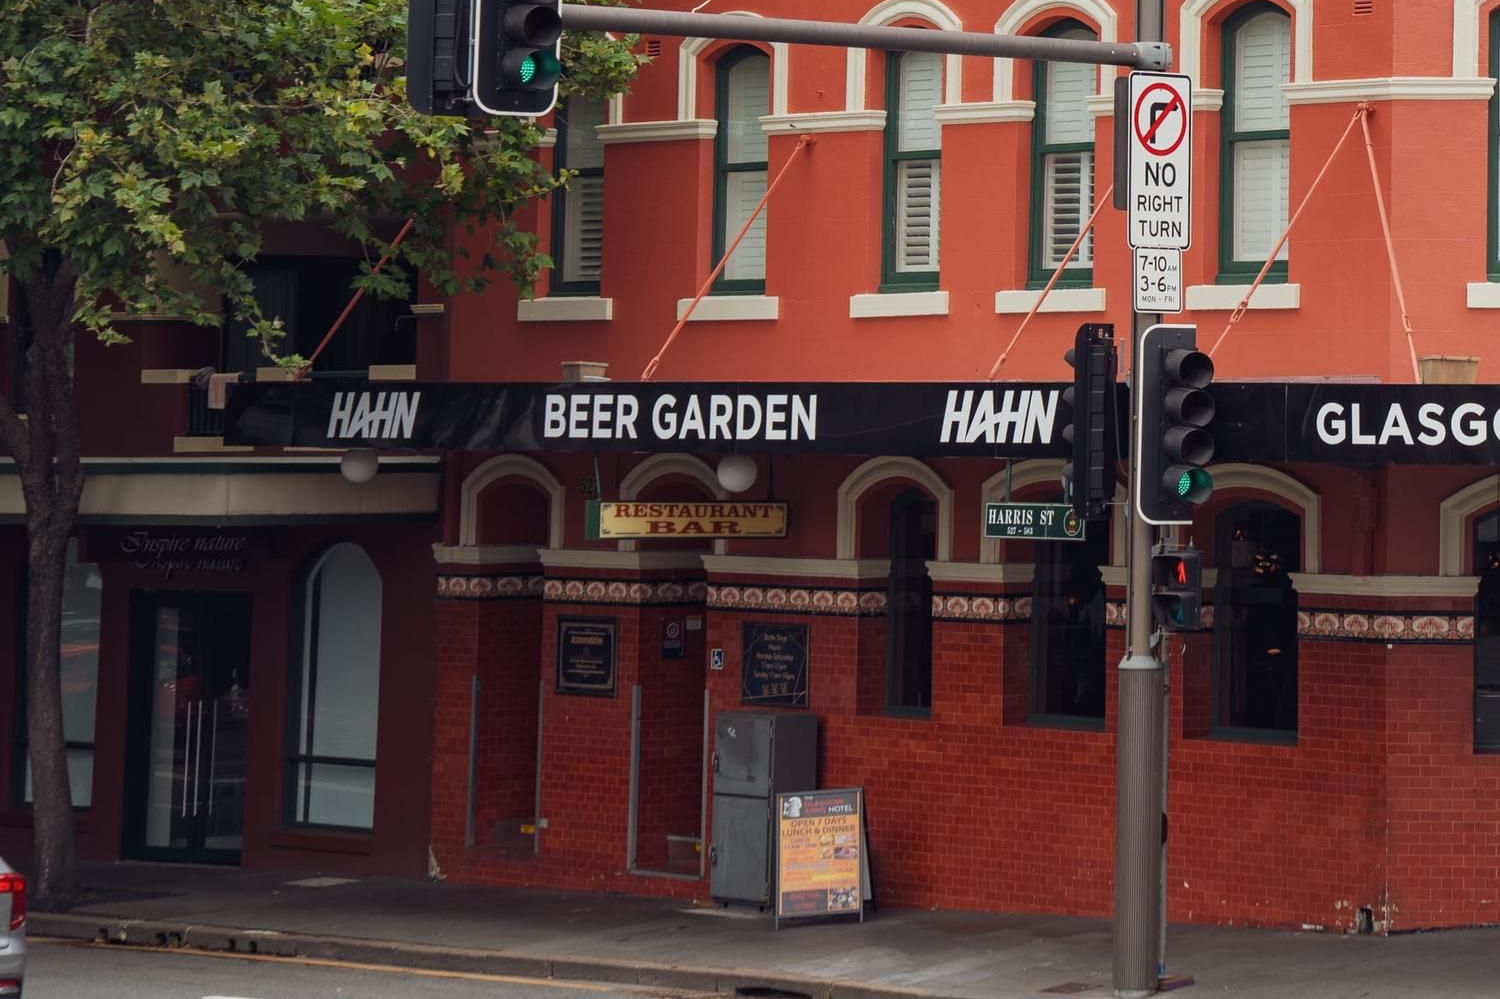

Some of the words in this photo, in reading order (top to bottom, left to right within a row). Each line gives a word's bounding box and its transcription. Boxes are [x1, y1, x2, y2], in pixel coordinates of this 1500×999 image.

[1144, 161, 1177, 188] NO
[1137, 194, 1183, 213] RIGHT
[1138, 219, 1182, 238] TURN
[1142, 295, 1156, 303] MON
[1164, 295, 1175, 303] FRI
[326, 391, 421, 439] HAHN
[543, 394, 638, 439] BEER
[652, 394, 818, 441] GARDEN
[939, 389, 1060, 444] HAHN
[614, 503, 774, 518] RESTAURANT
[988, 508, 1033, 525] HARRIS
[1039, 510, 1055, 526] ST
[645, 520, 742, 535] BAR
[120, 531, 191, 559] Inspire
[194, 535, 246, 551] nature
[828, 803, 853, 814] HOTEL
[782, 826, 813, 837] LUNCH
[822, 823, 856, 834] DINNER
[791, 818, 816, 829] OPEN
[824, 815, 848, 826] DAYS
